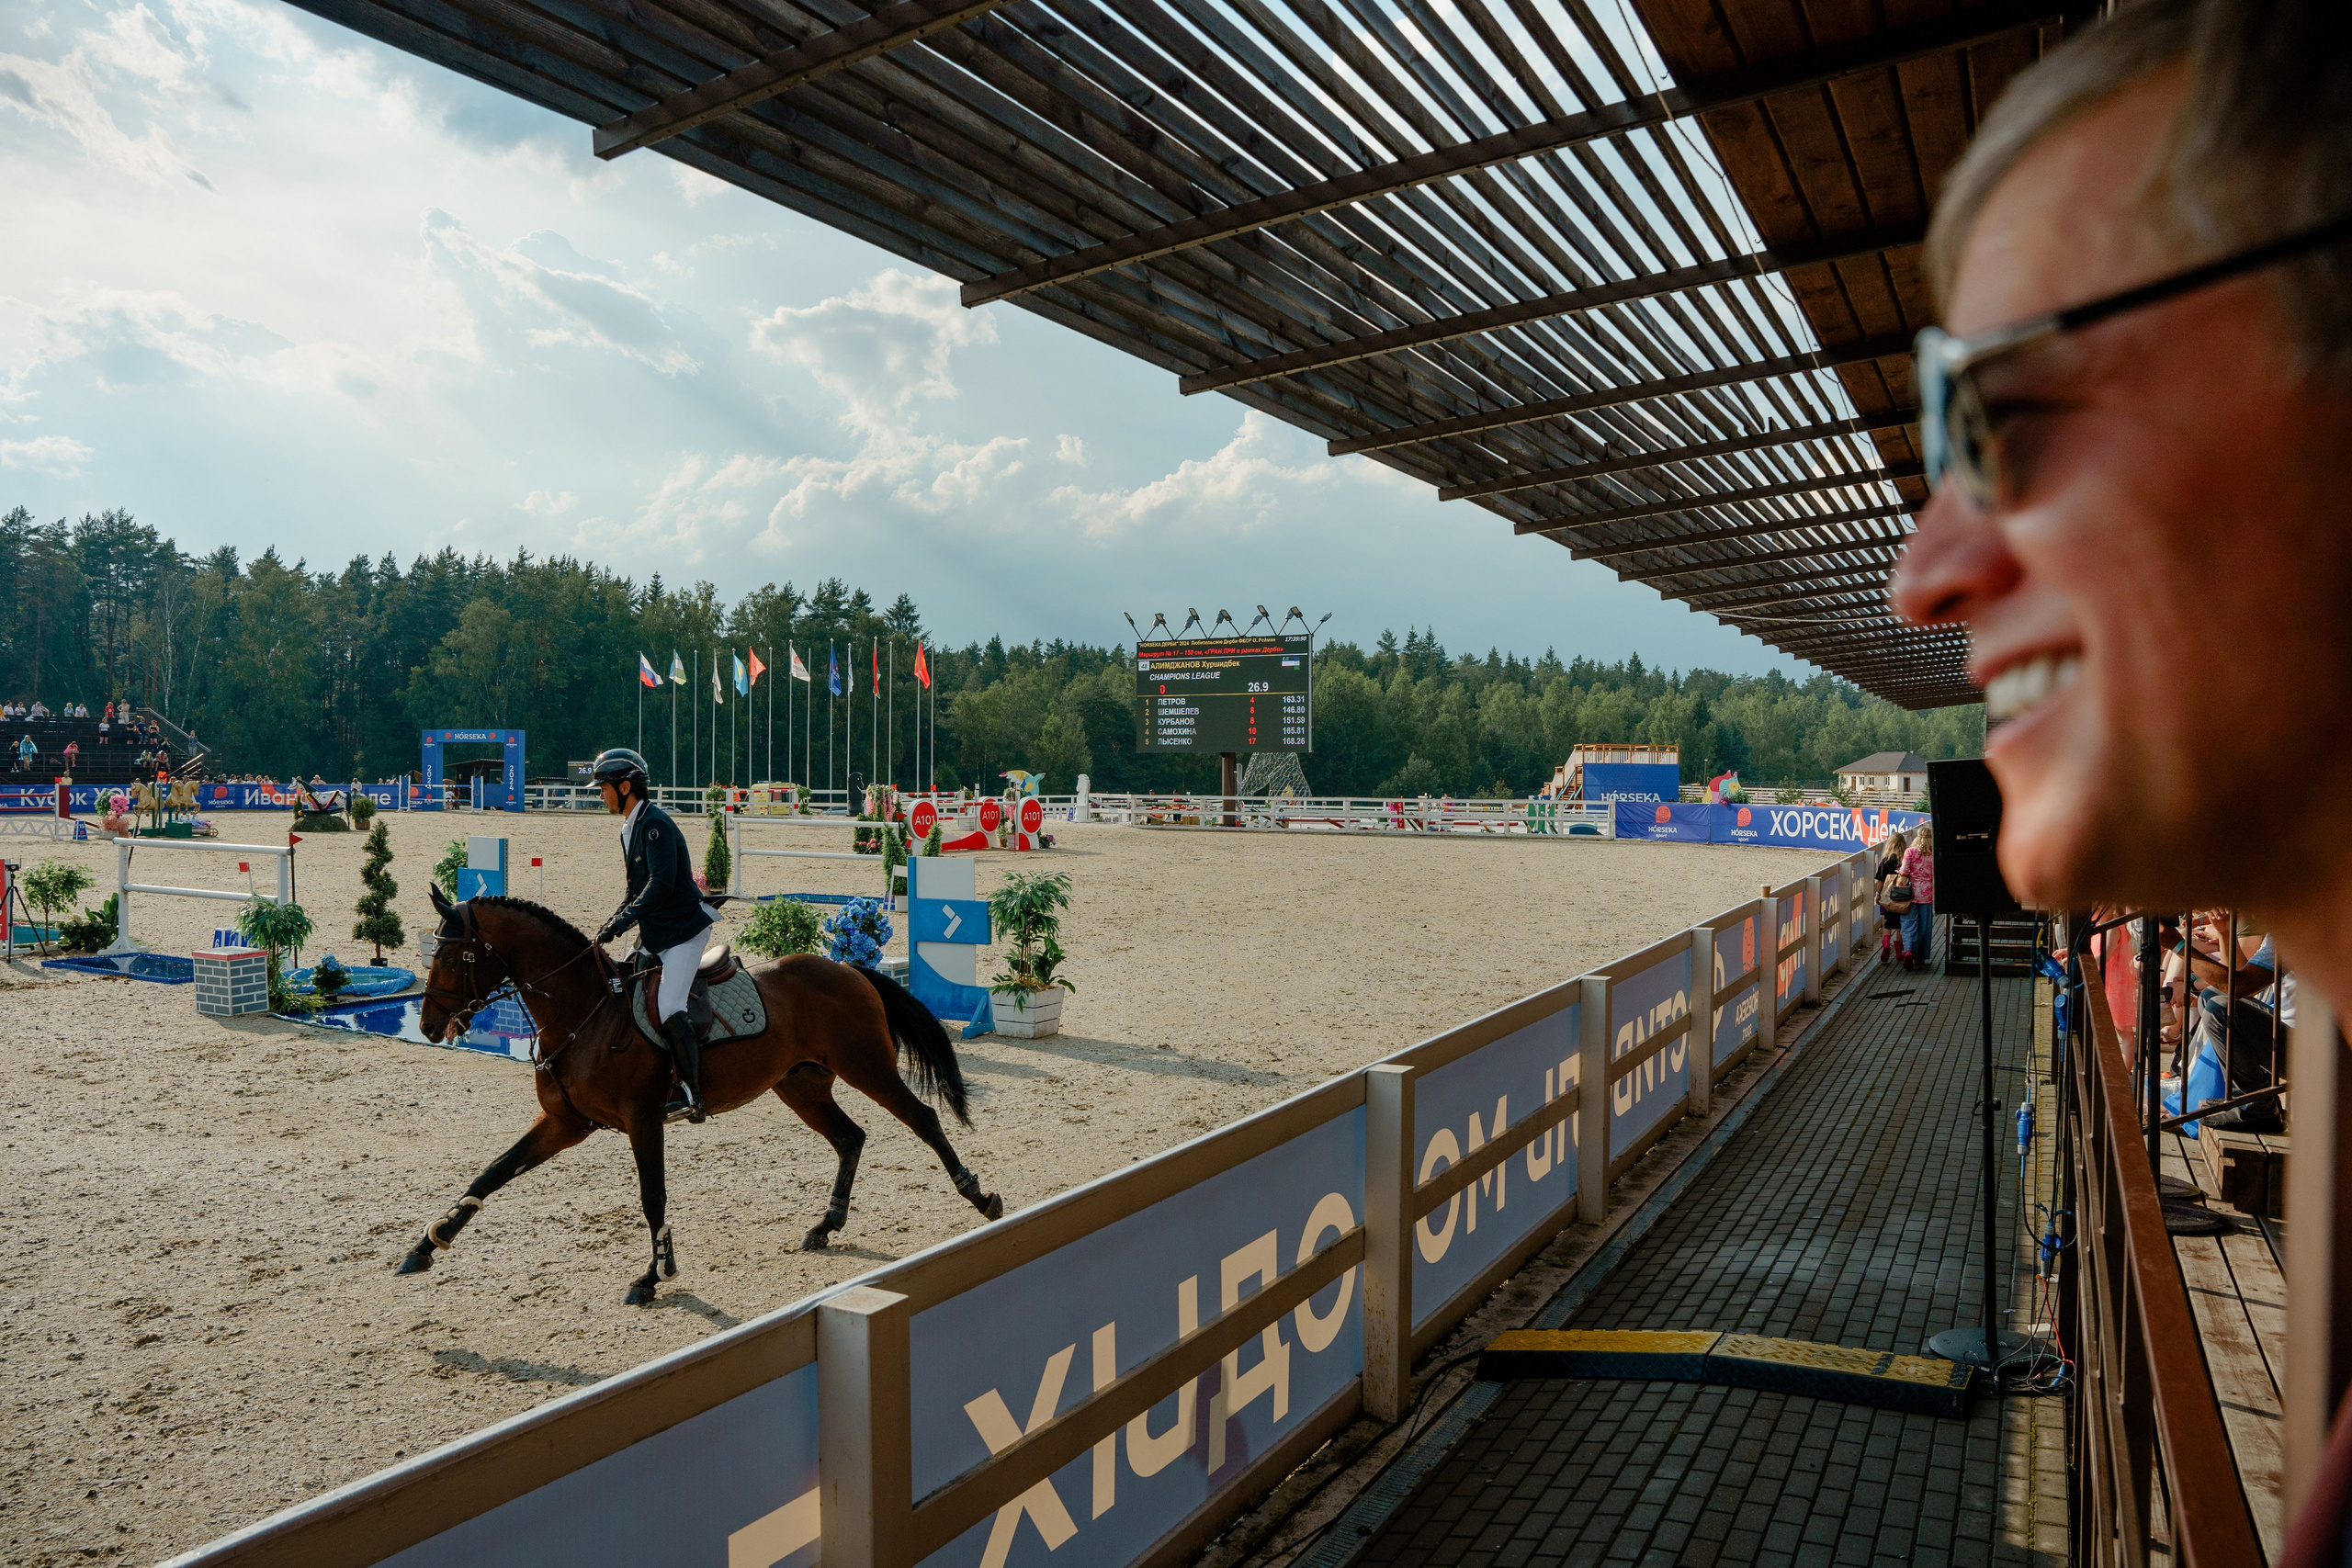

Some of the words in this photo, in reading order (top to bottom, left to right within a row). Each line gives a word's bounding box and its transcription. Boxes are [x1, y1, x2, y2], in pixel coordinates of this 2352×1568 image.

[1150, 660, 1200, 671] АЛИМДЖАНОВ
[1202, 660, 1240, 670] Хуршидбек
[1149, 672, 1191, 682] CHAMPIONS
[1191, 671, 1220, 680] LEAGUE
[1159, 684, 1165, 694] 0
[1248, 682, 1269, 693] 26.9
[454, 731, 487, 740] HÓRSEKA
[982, 810, 998, 820] A101
[1023, 811, 1040, 821] A101
[915, 816, 935, 825] A101
[1770, 810, 1863, 841] ХОРСЕКА
[1648, 825, 1678, 834] HÓRSEKA
[1731, 829, 1758, 838] HÓRSEKA
